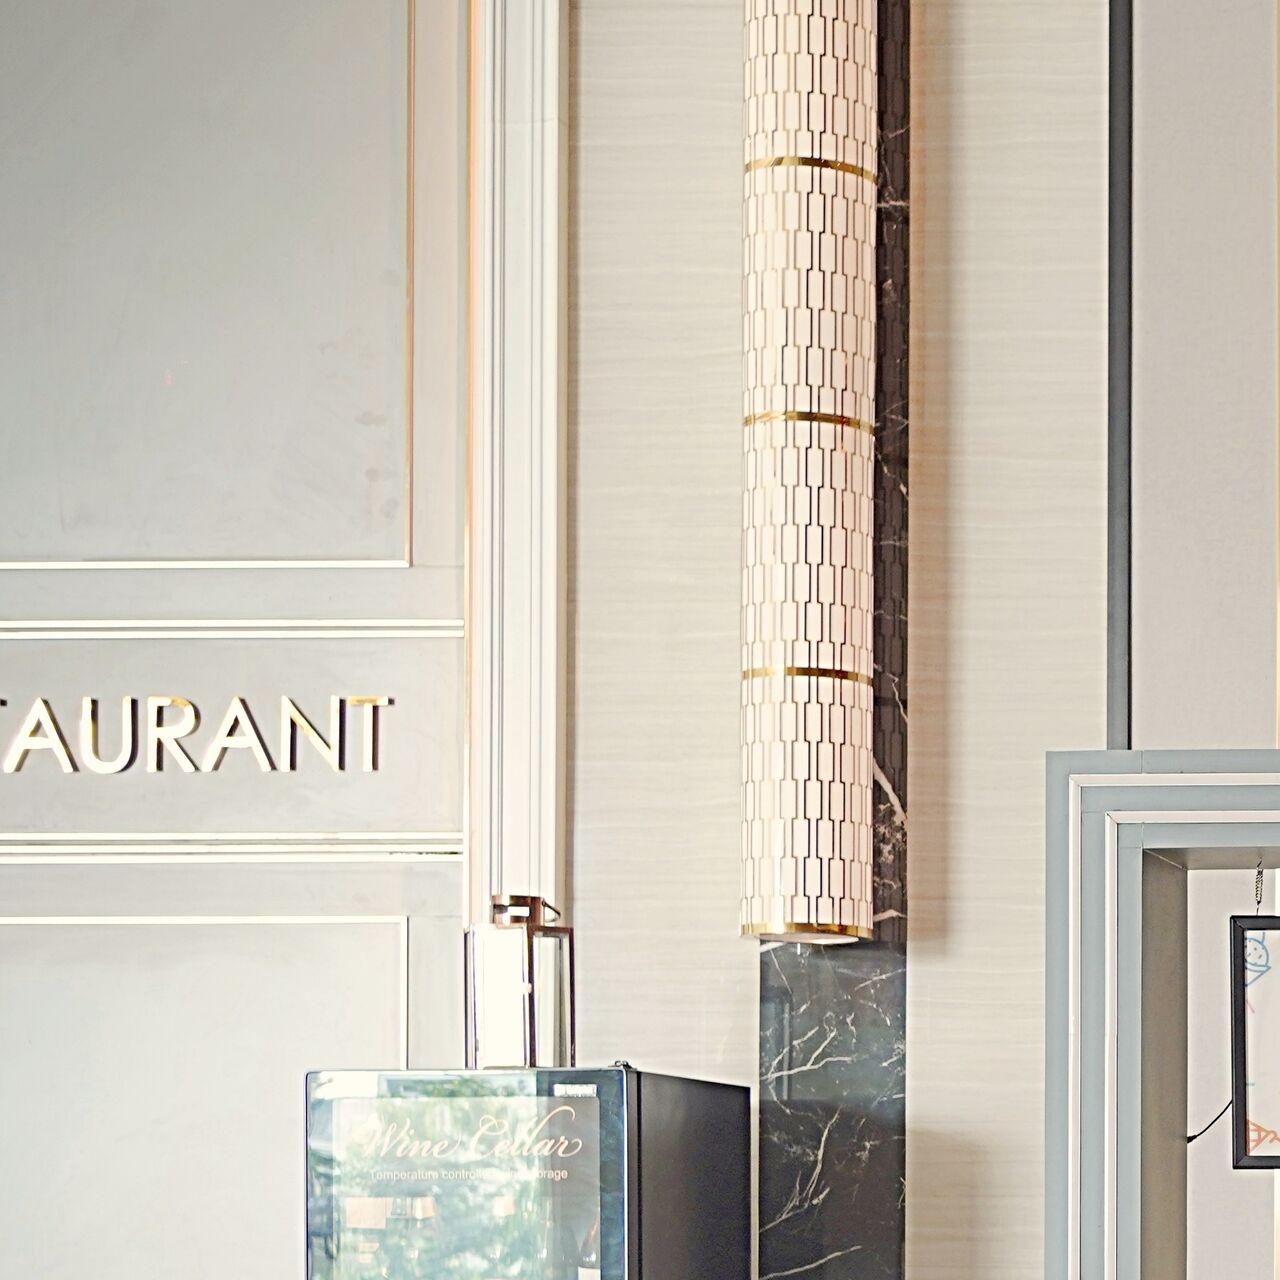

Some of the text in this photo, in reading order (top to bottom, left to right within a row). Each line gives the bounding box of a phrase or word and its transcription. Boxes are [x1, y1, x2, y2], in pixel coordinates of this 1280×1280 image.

[0, 696, 393, 774] AURANT
[363, 1104, 583, 1161] Wine Cellar
